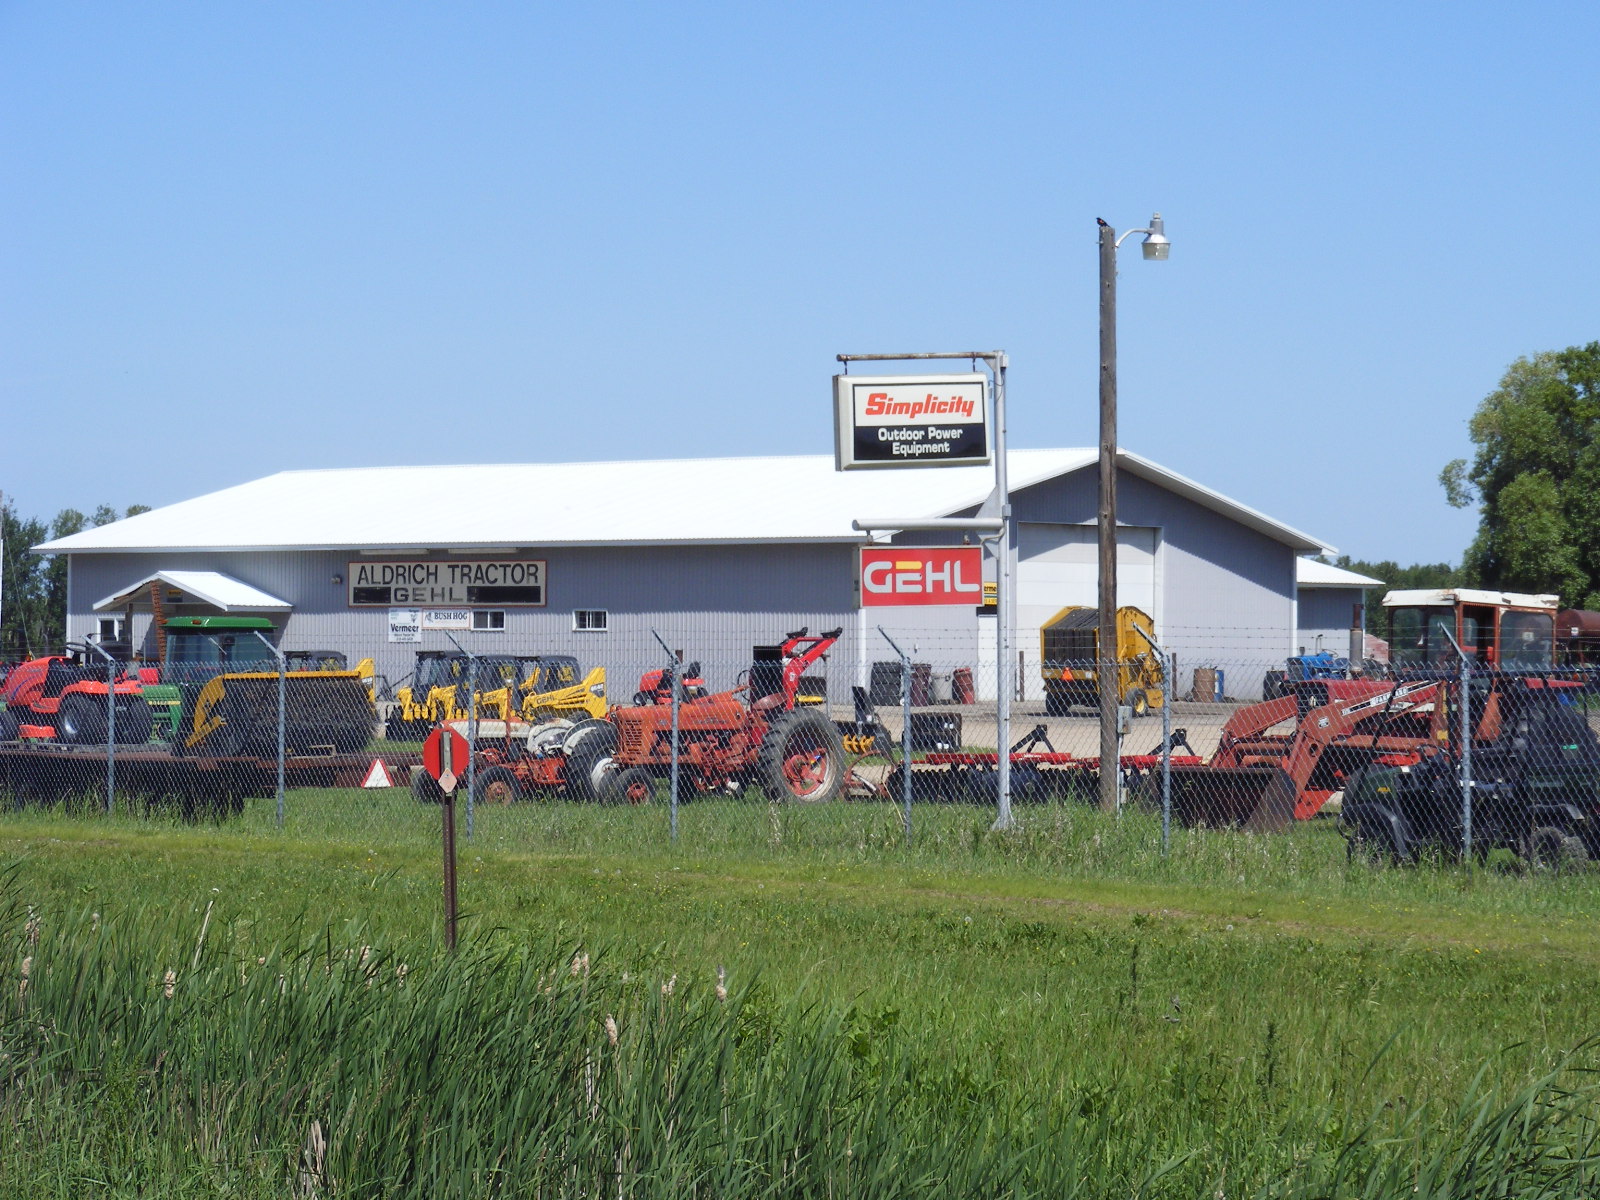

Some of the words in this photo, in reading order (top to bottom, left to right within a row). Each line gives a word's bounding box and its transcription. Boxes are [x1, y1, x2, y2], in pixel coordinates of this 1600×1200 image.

[866, 393, 975, 418] Simplicity
[878, 428, 925, 441] Outdoor
[928, 427, 963, 440] Power
[892, 441, 950, 456] Equipment
[357, 564, 438, 585] ALDRICH
[448, 563, 539, 584] TRACTOR
[863, 560, 980, 593] GEHL
[394, 587, 464, 603] GEHL
[434, 612, 452, 620] BUSH
[452, 612, 468, 620] HOG
[390, 623, 419, 632] Vermeer
